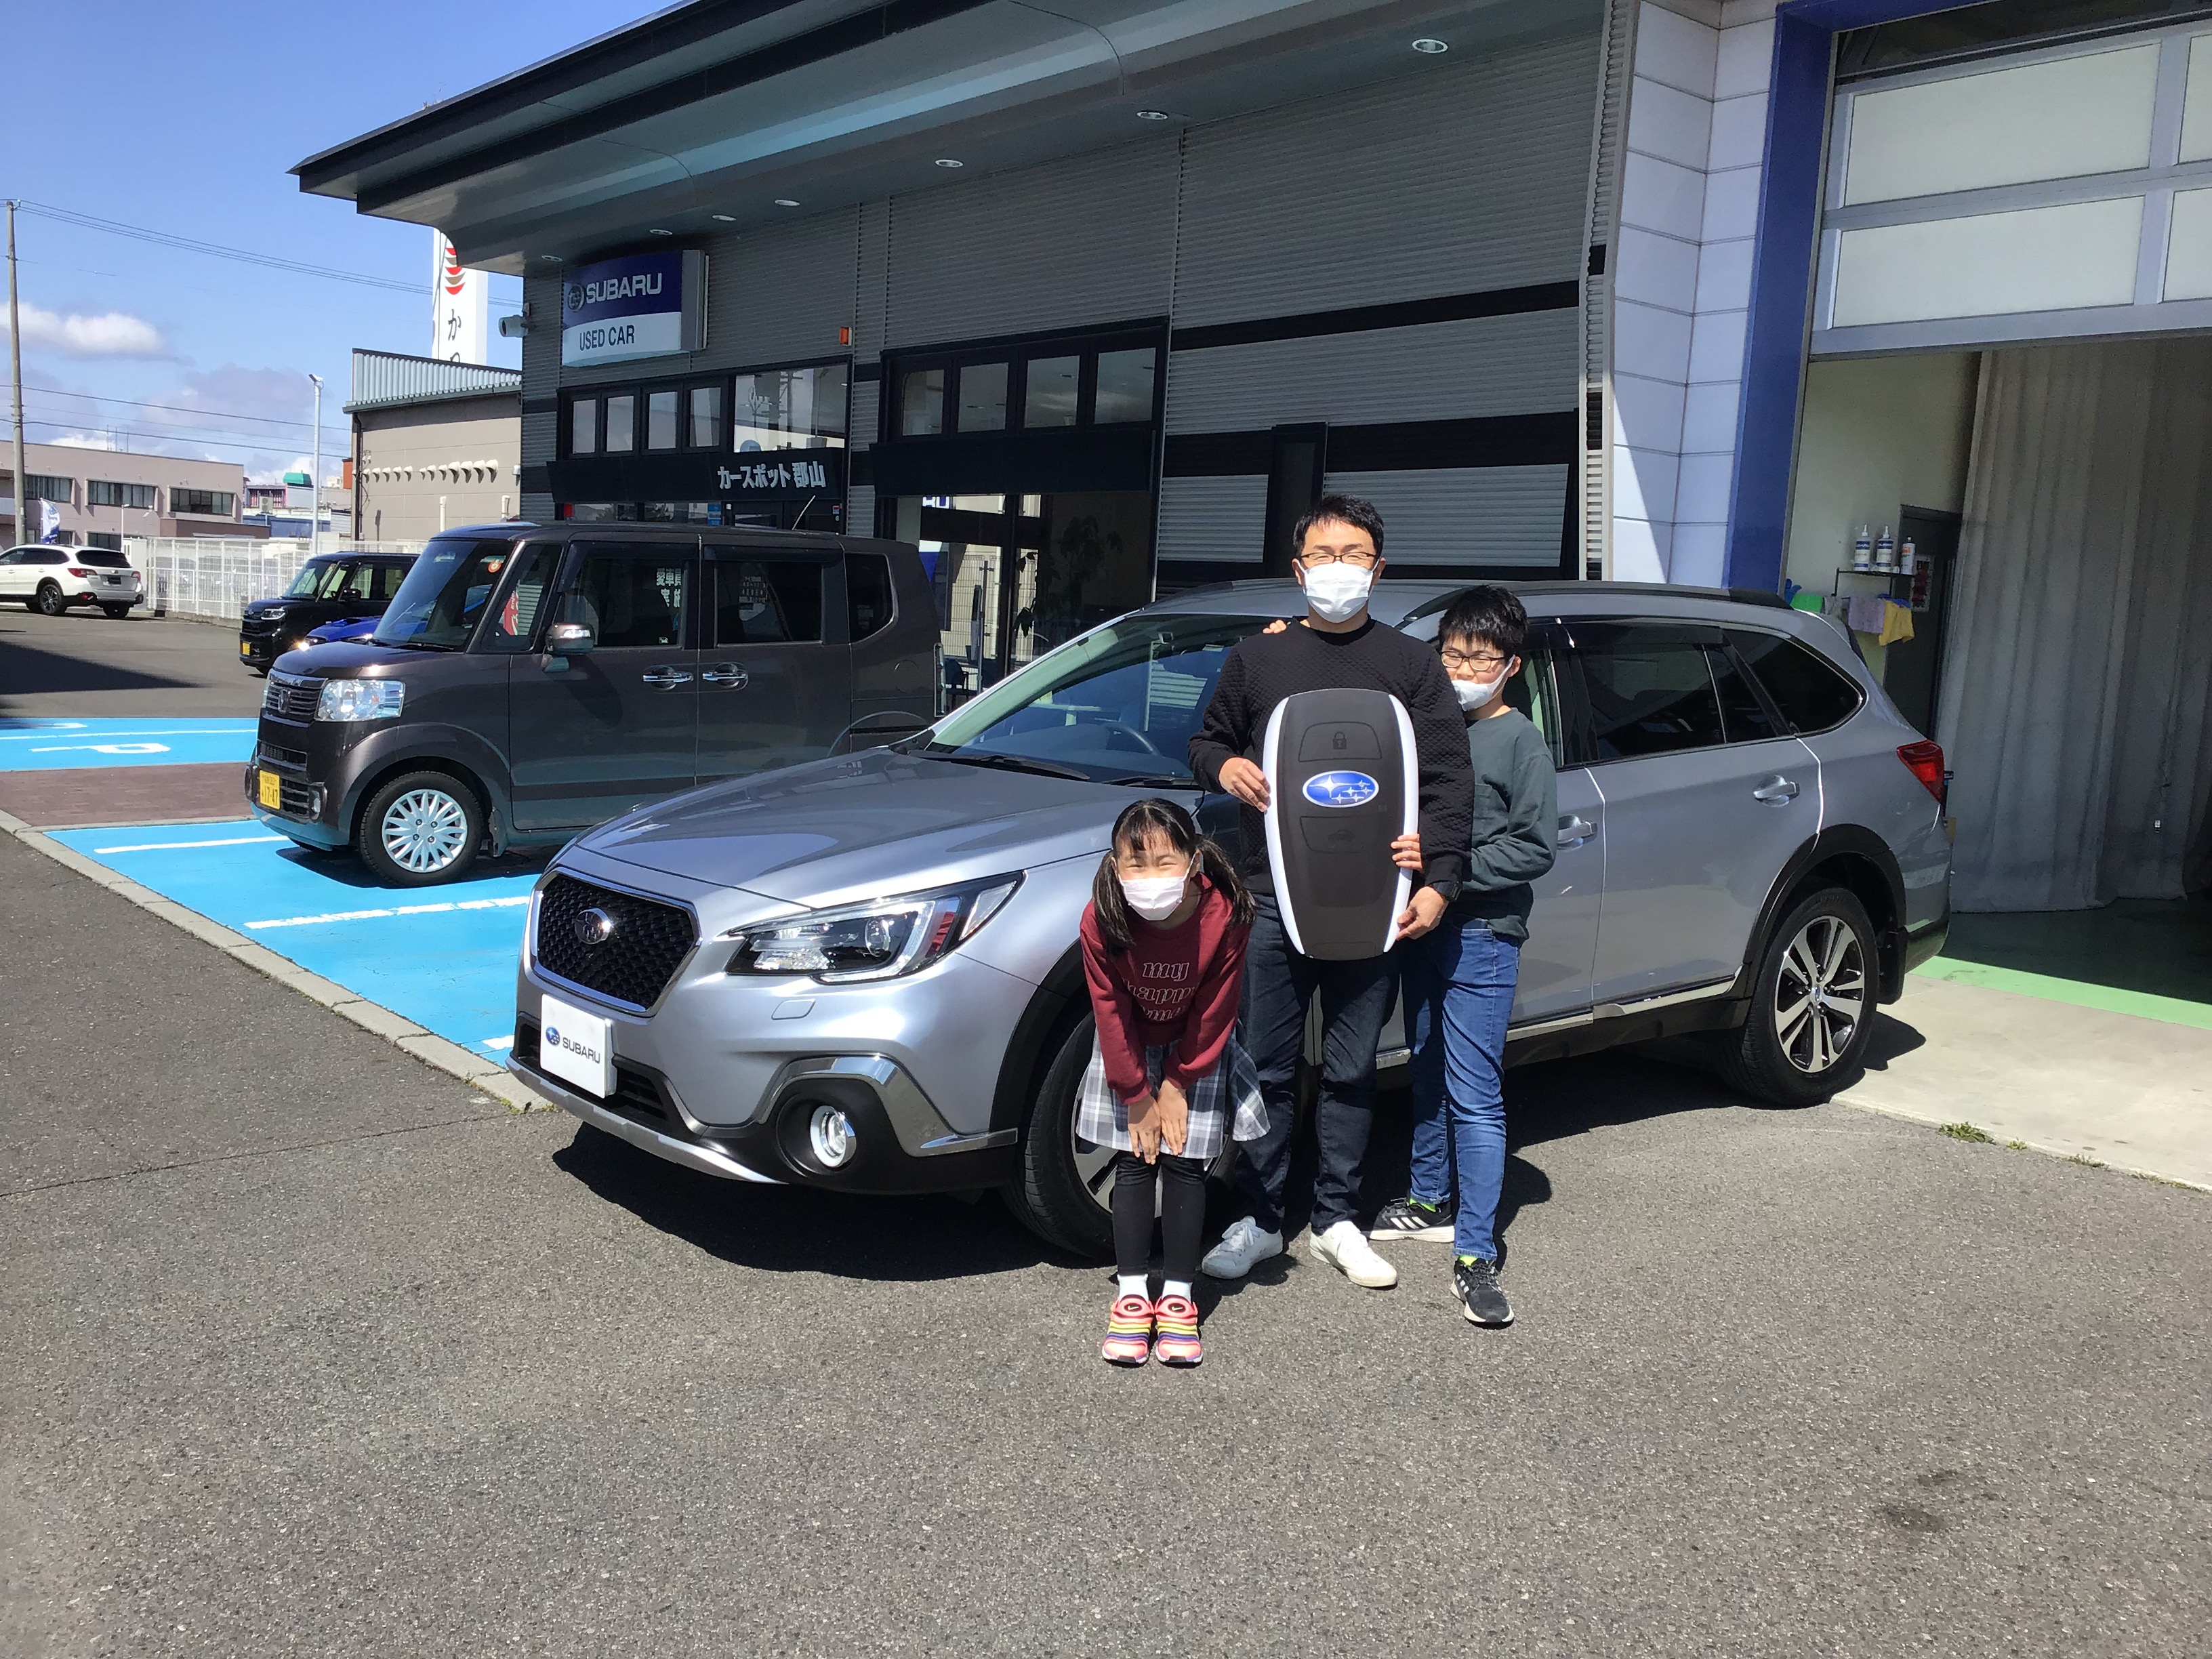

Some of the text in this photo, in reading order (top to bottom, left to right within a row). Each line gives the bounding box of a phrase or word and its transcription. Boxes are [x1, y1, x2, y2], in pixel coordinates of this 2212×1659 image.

[586, 272, 662, 304] SUBARU
[579, 325, 635, 350] USED CAR
[717, 461, 826, 489] カースポット郡山
[1142, 962, 1189, 981] my
[562, 1037, 600, 1064] SUBARU
